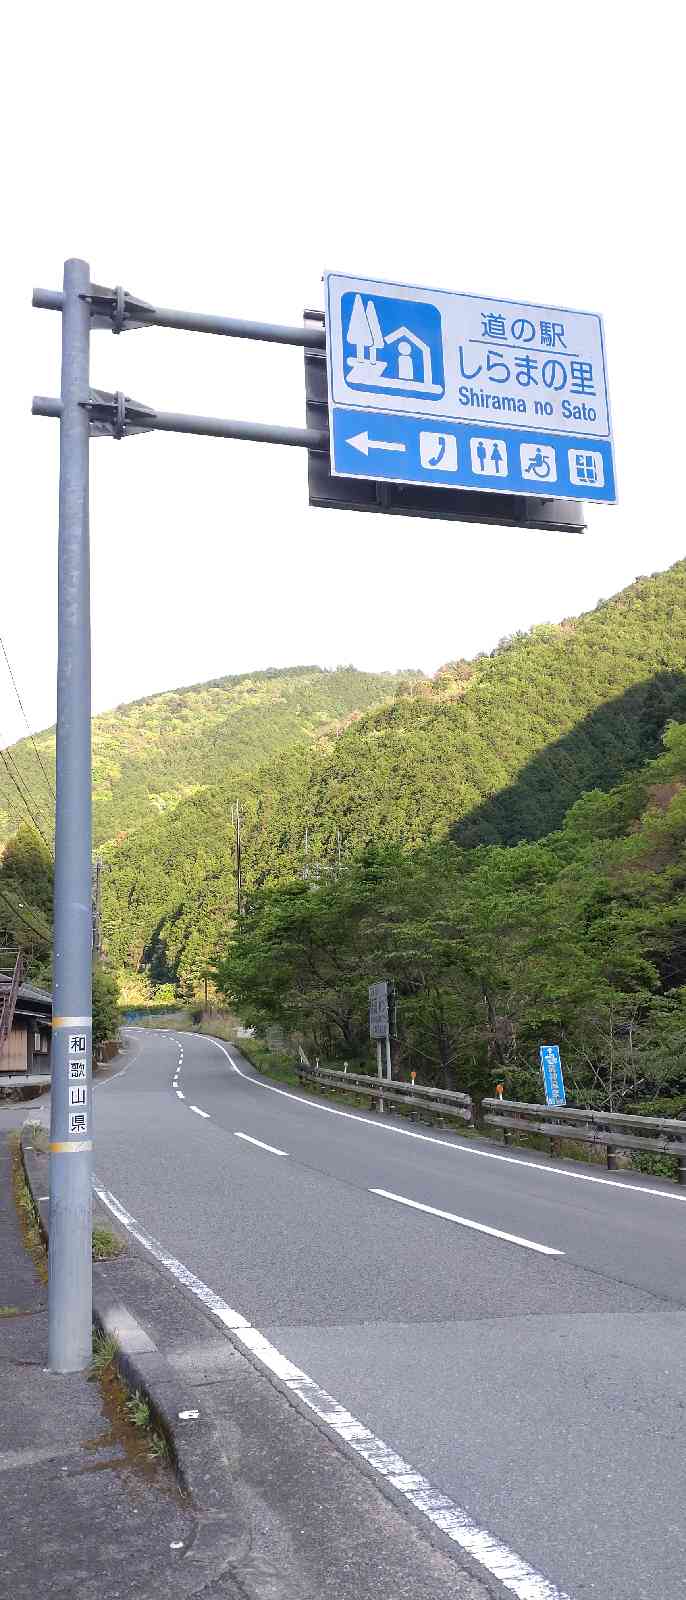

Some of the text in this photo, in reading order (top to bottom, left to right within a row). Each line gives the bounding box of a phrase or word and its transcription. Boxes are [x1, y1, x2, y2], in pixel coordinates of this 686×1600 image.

[481, 312, 567, 349] 道の駅
[458, 345, 597, 397] しらまの里
[458, 385, 597, 422] Shirama no Sato
[70, 1035, 87, 1133] 和歌山県
